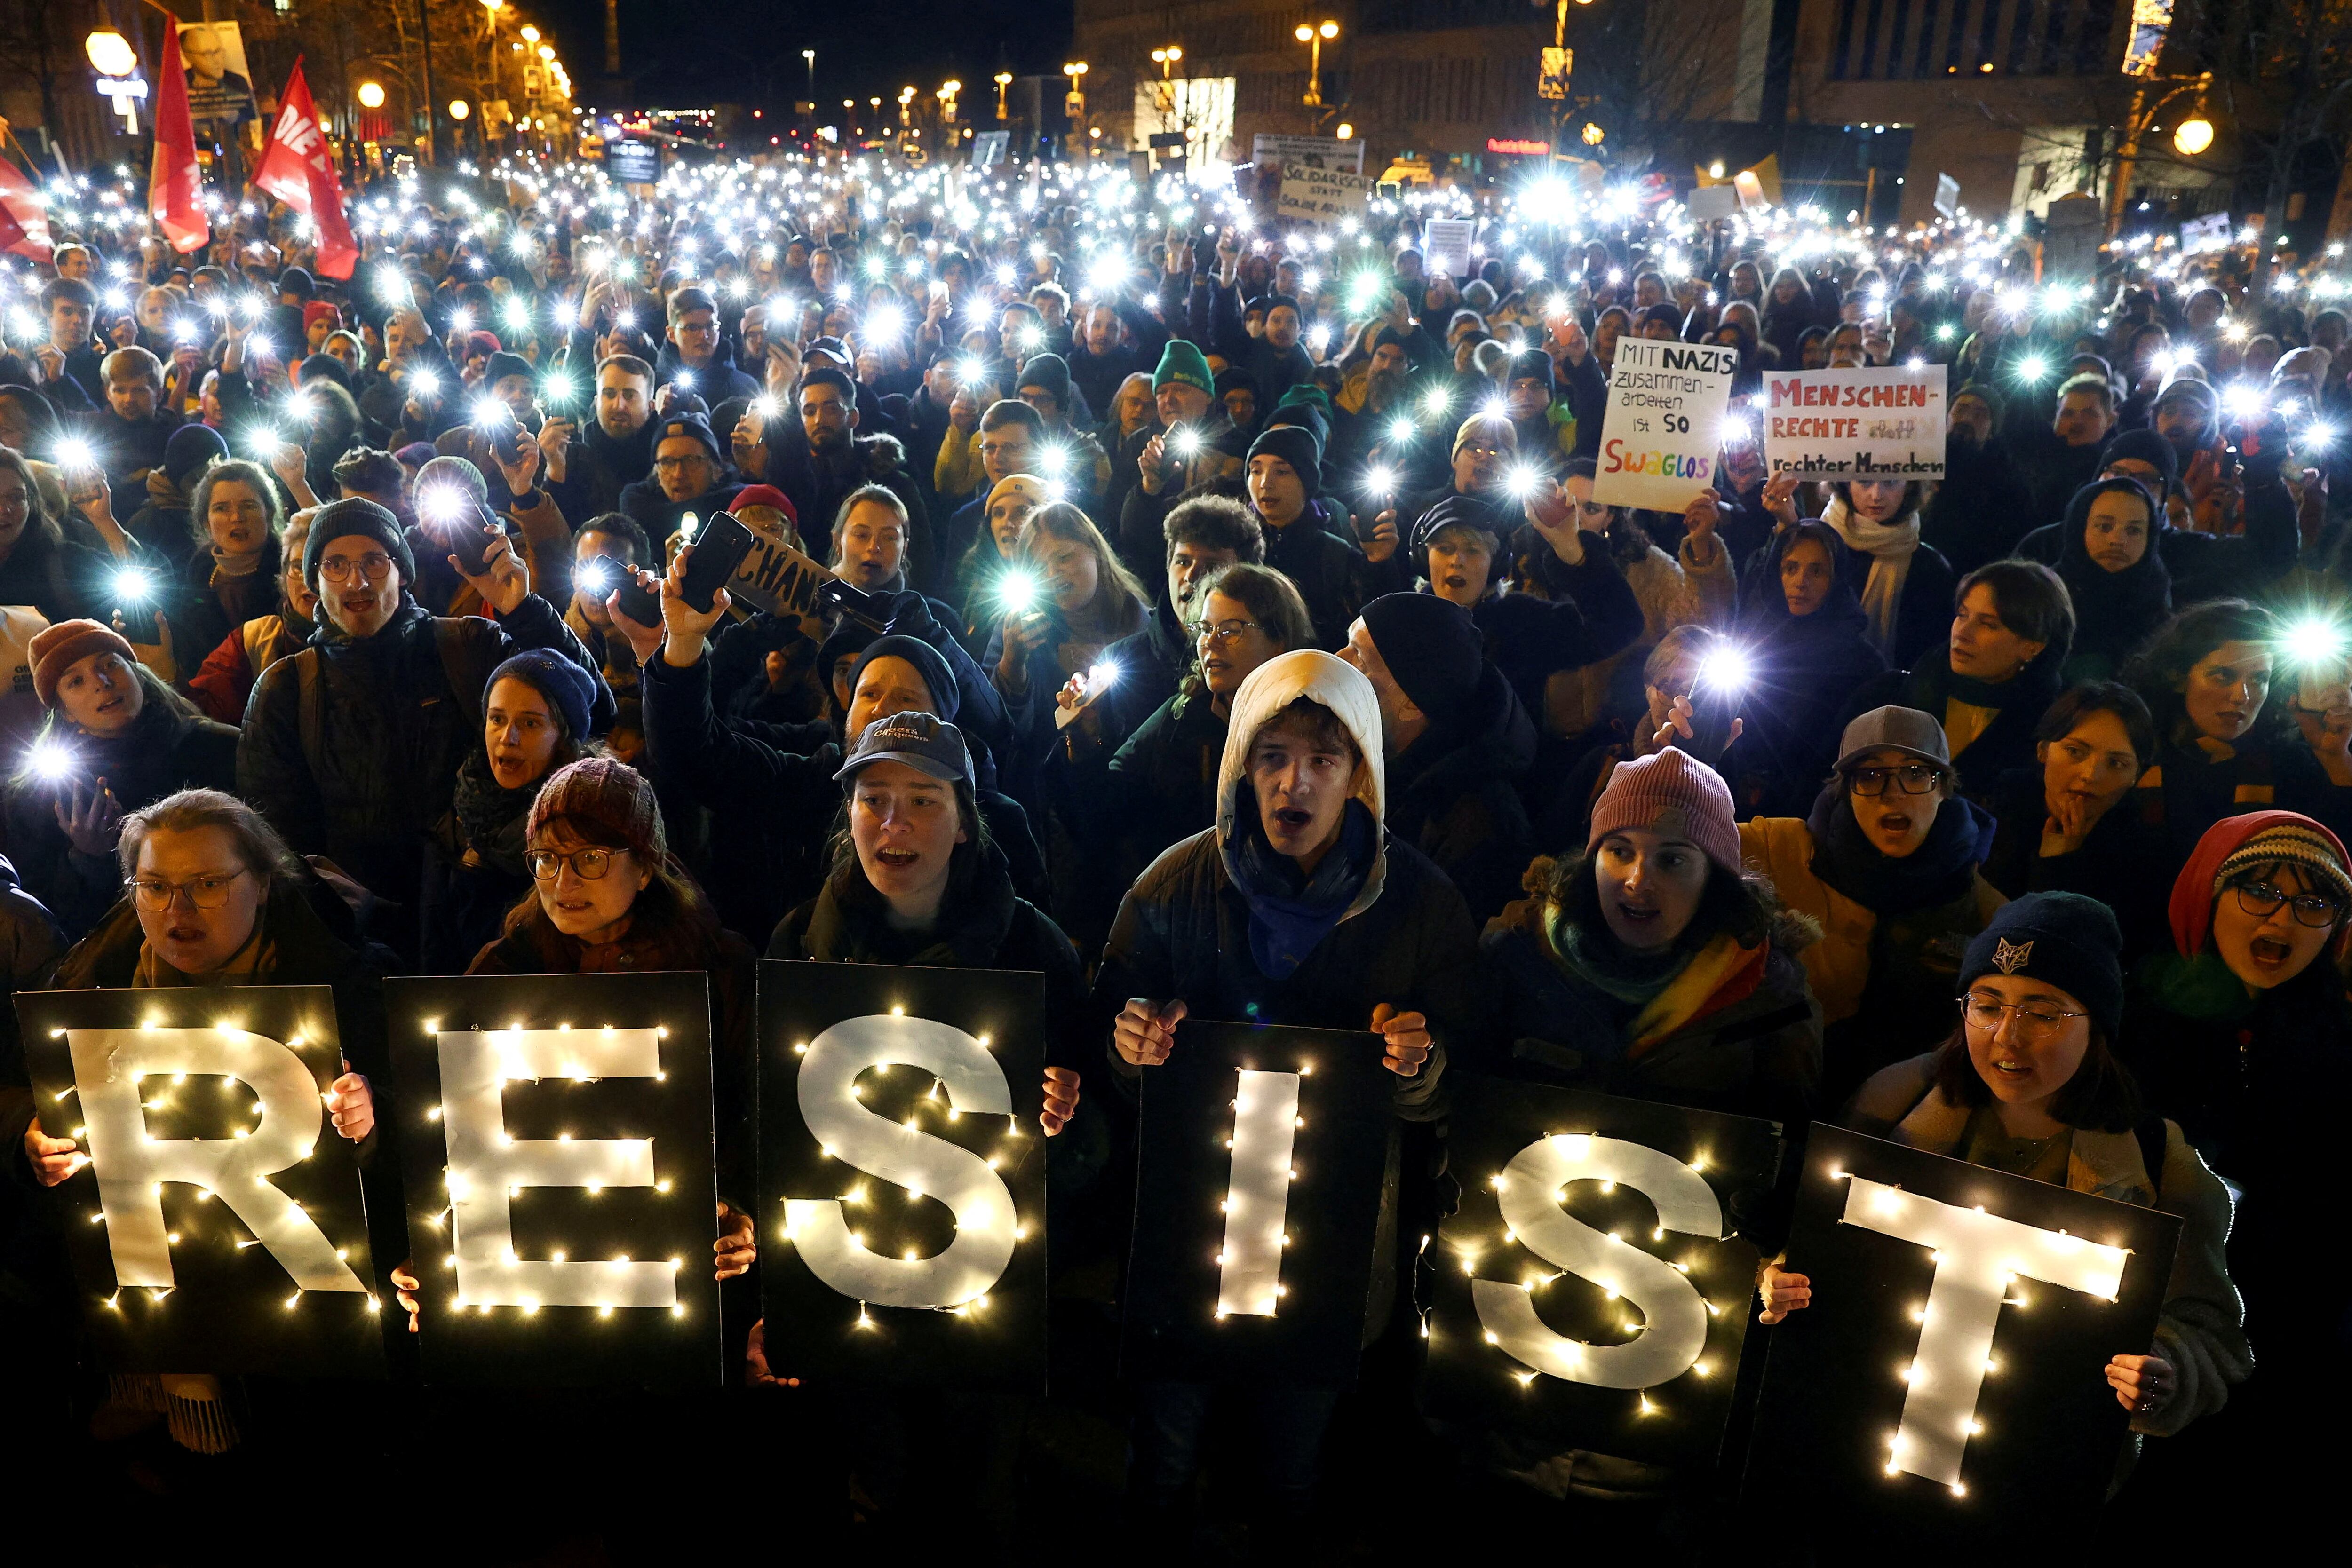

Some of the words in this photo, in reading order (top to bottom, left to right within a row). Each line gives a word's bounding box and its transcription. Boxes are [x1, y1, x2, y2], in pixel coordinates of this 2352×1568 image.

[274, 104, 320, 156] DIE
[1622, 344, 1659, 366] MIT
[1662, 348, 1735, 374] NAZIS
[1663, 413, 1690, 433] SO
[1772, 417, 1859, 438] RECHTE
[1773, 453, 1851, 473] rechter
[1855, 451, 1944, 473] Menschen
[67, 1015, 2128, 1485] RESIST
